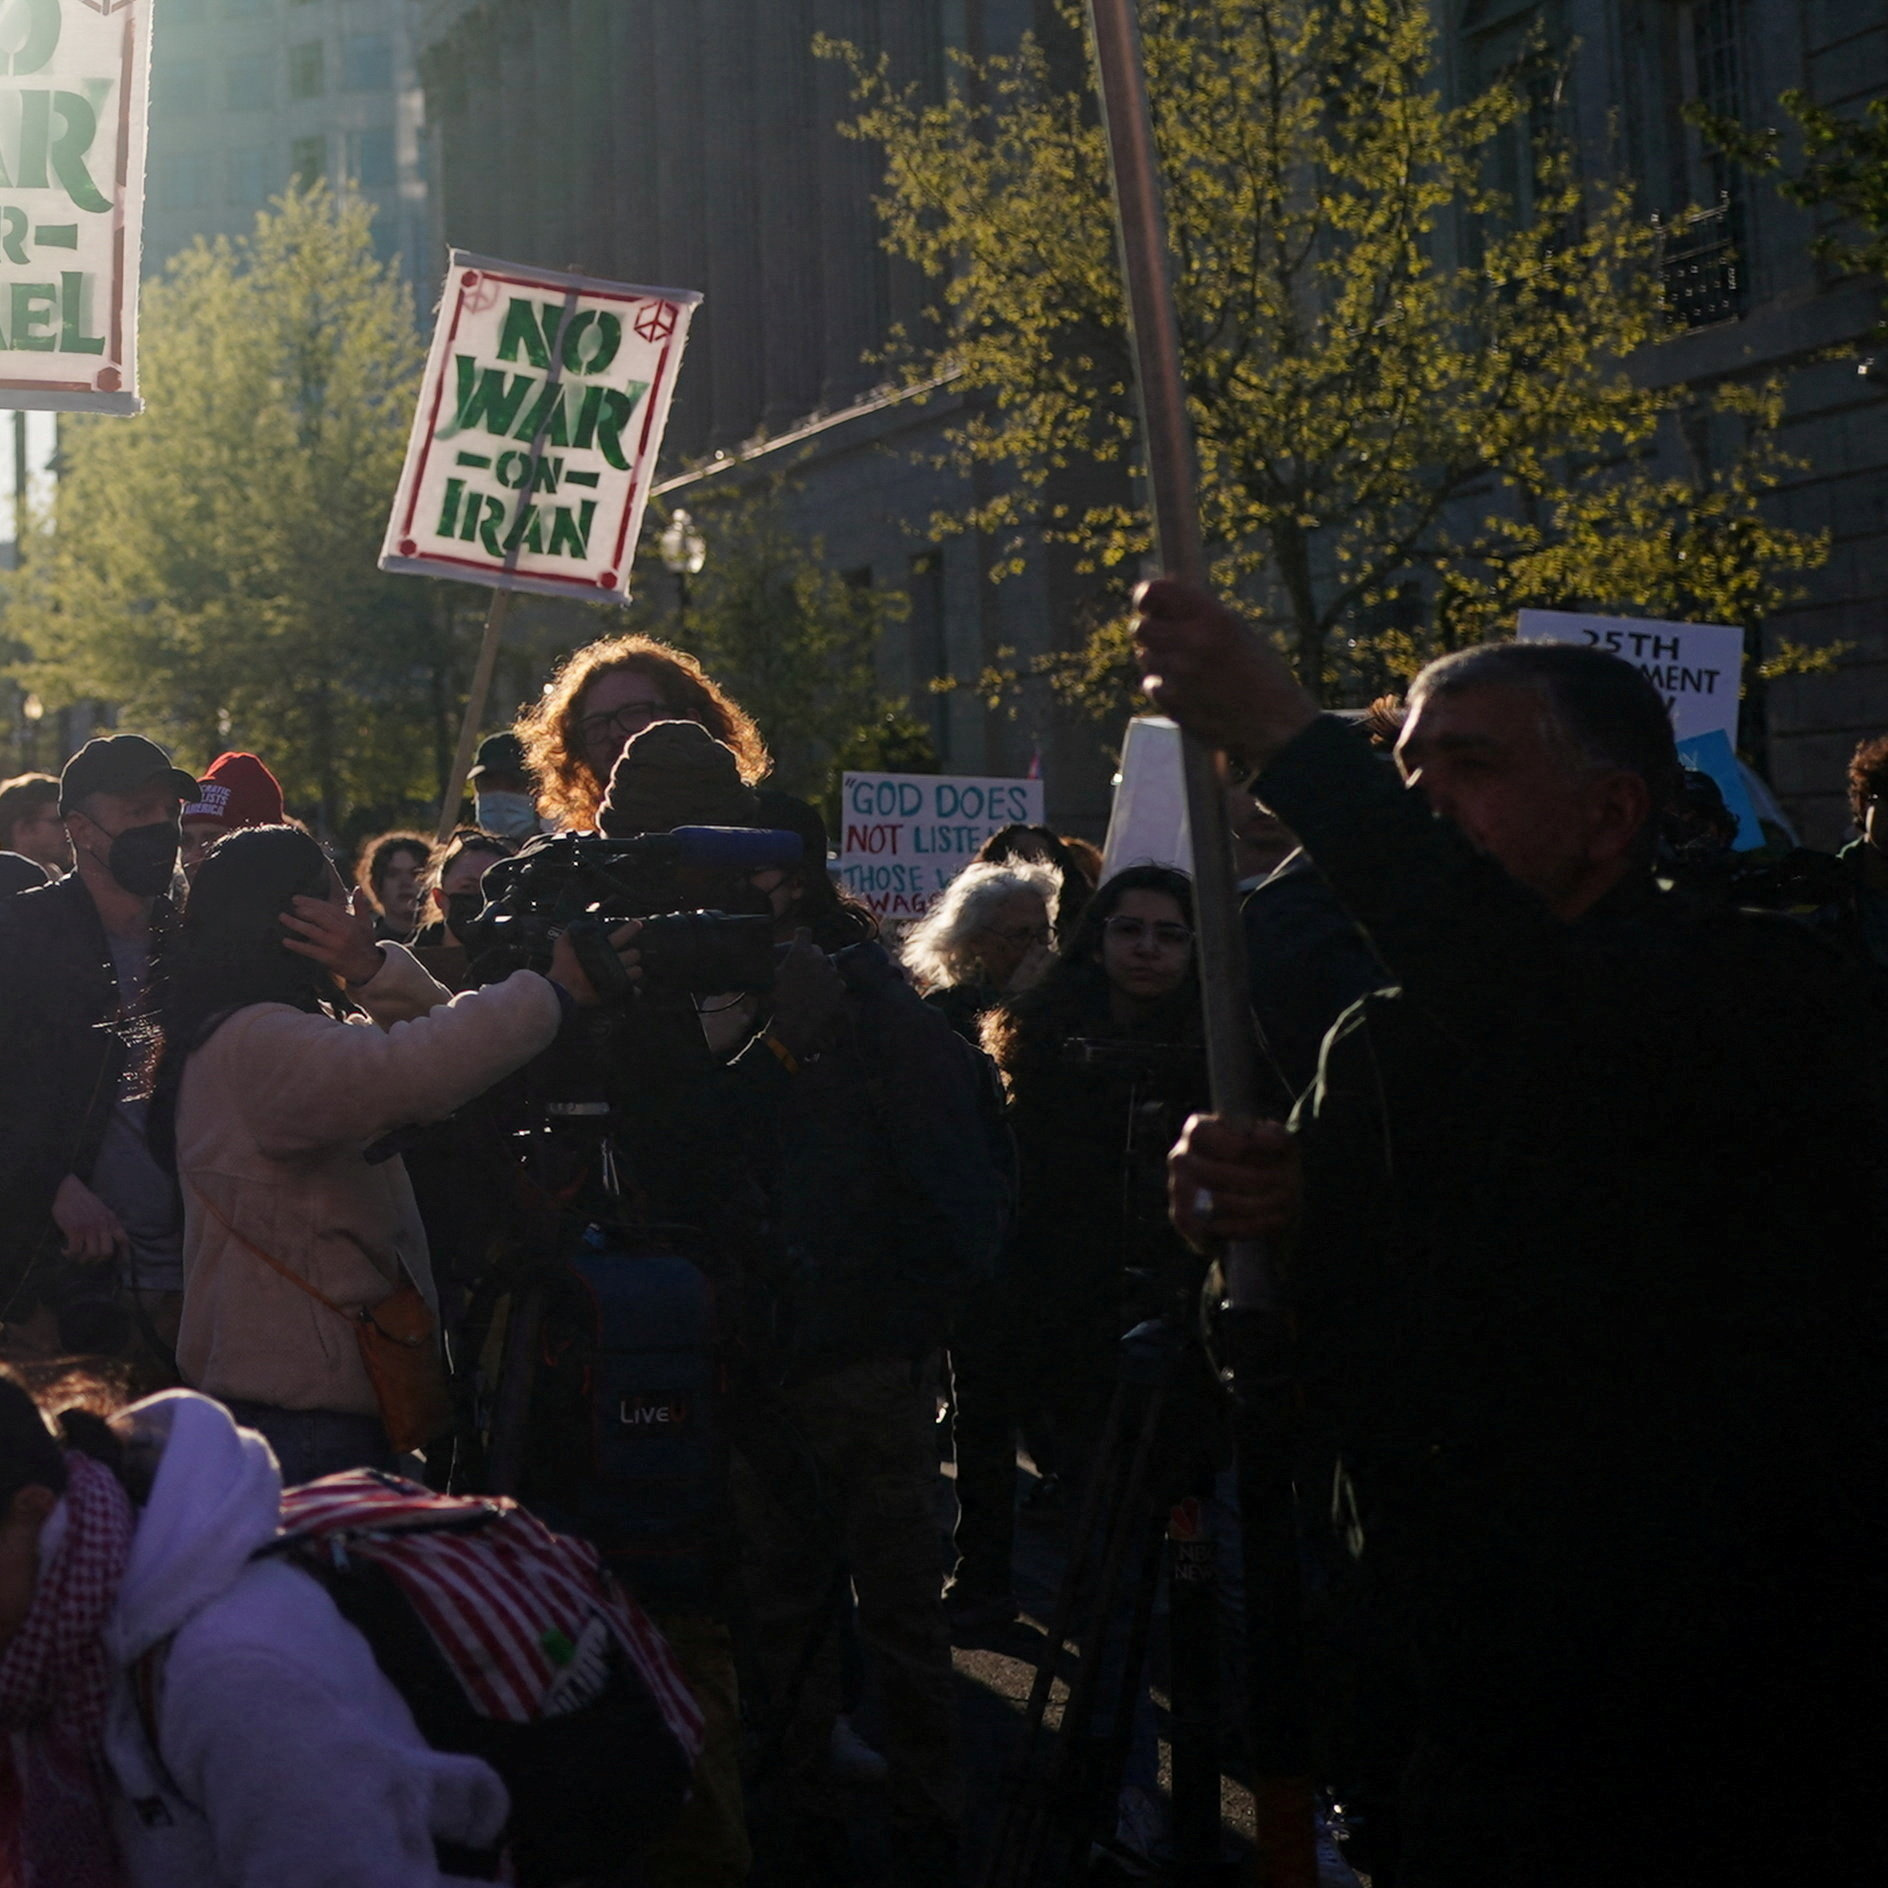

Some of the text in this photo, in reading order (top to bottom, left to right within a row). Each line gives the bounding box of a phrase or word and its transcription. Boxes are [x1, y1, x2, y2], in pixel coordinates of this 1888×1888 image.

[497, 298, 621, 376] NO
[455, 354, 632, 471] WAR
[436, 478, 597, 560] IRAN
[936, 785, 1028, 821] DOES
[846, 824, 994, 855] NOT LISTE
[843, 864, 923, 892] THOSE
